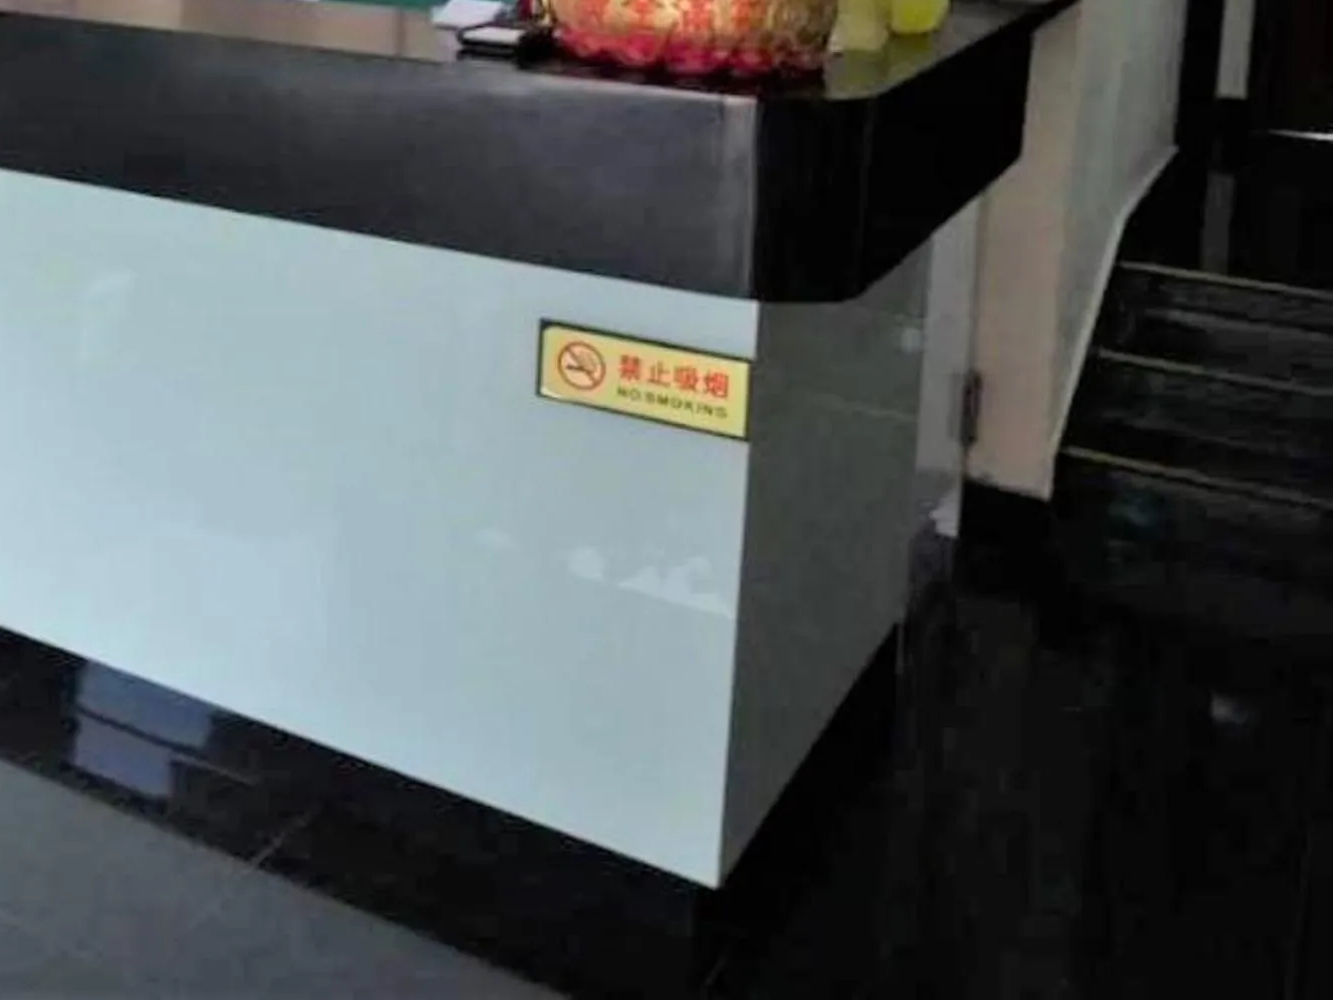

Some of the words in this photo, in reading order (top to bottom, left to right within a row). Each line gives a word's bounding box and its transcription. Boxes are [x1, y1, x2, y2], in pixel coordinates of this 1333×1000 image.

[618, 354, 729, 398] 禁止吸烟
[617, 386, 641, 401] NO
